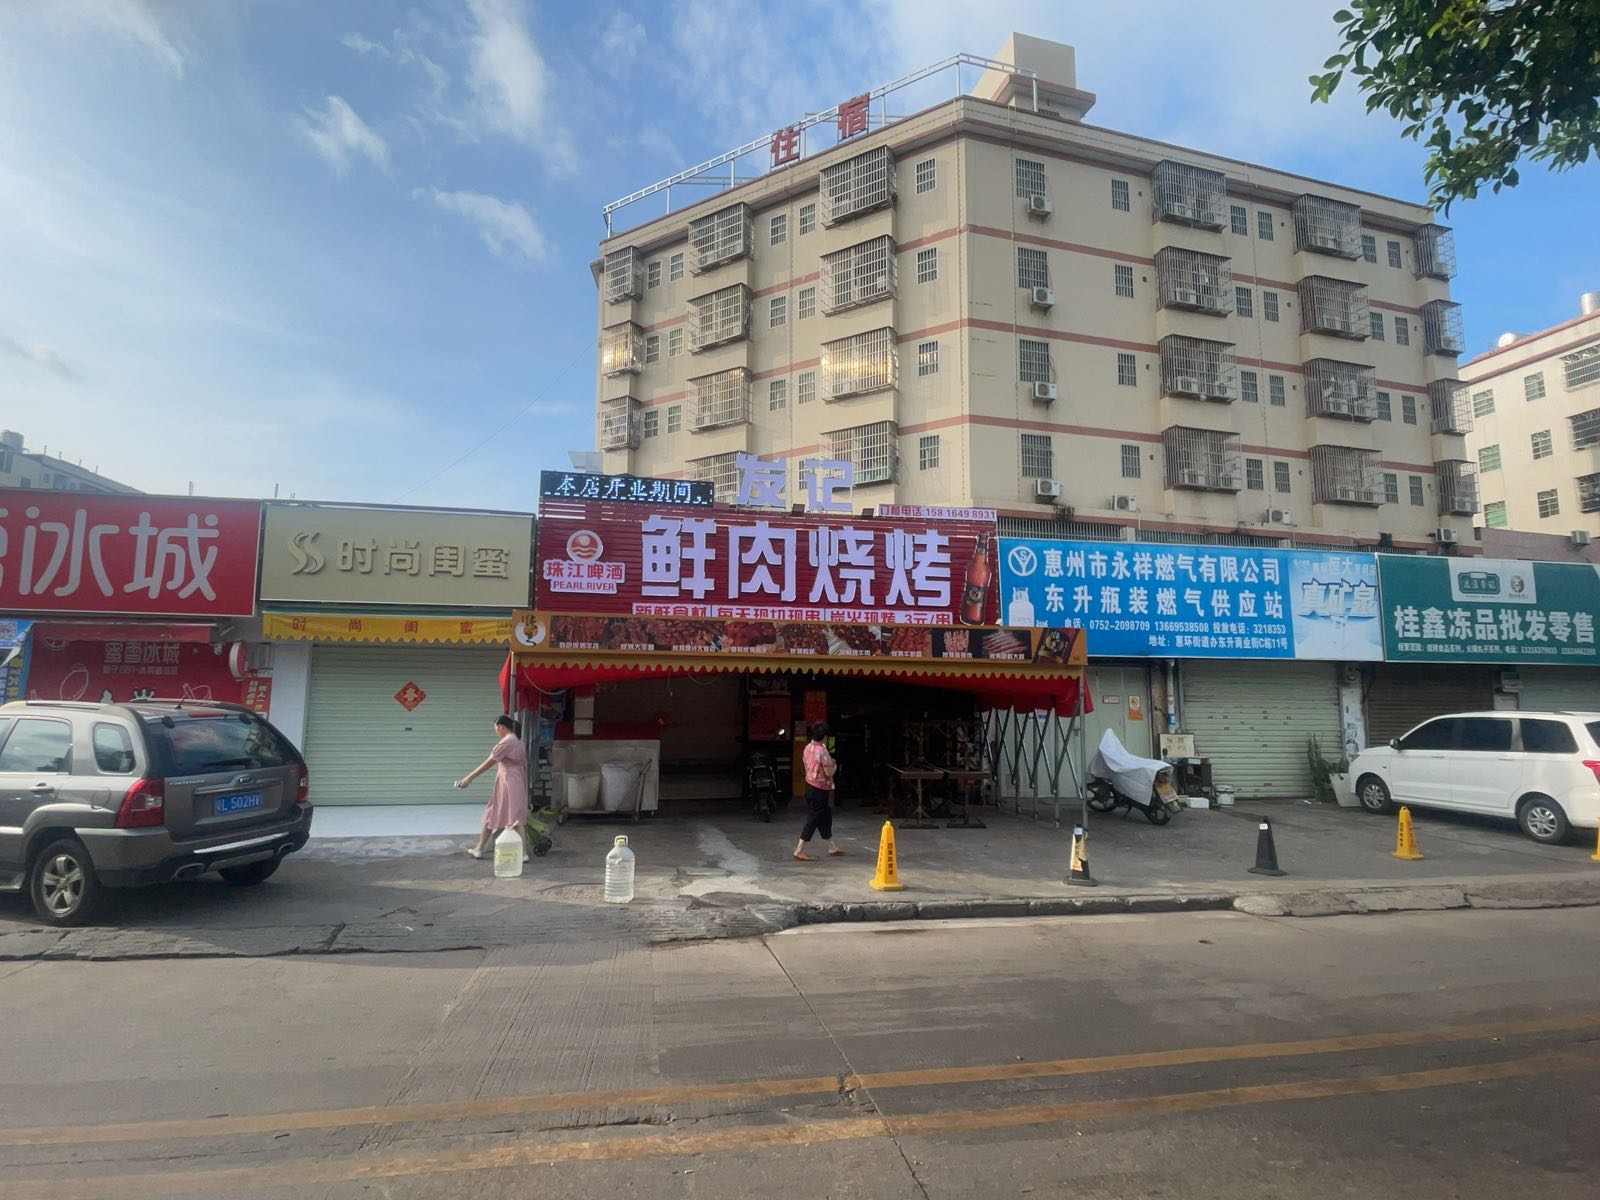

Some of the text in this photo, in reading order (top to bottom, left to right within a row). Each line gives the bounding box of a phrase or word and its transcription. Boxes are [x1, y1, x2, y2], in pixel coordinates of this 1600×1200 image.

[771, 92, 869, 167] 住宿
[0, 505, 220, 601] 冰城
[337, 537, 510, 579] 时尚闺蜜
[546, 561, 622, 580] 珠江啤酒
[641, 515, 951, 607] 鲜肉烧烤
[1043, 548, 1280, 585] 惠州市永祥燃气有限公司
[1044, 583, 1283, 619] 东升瓶装燃气供应站
[1394, 605, 1595, 643] 桂鑫冻品批发零售
